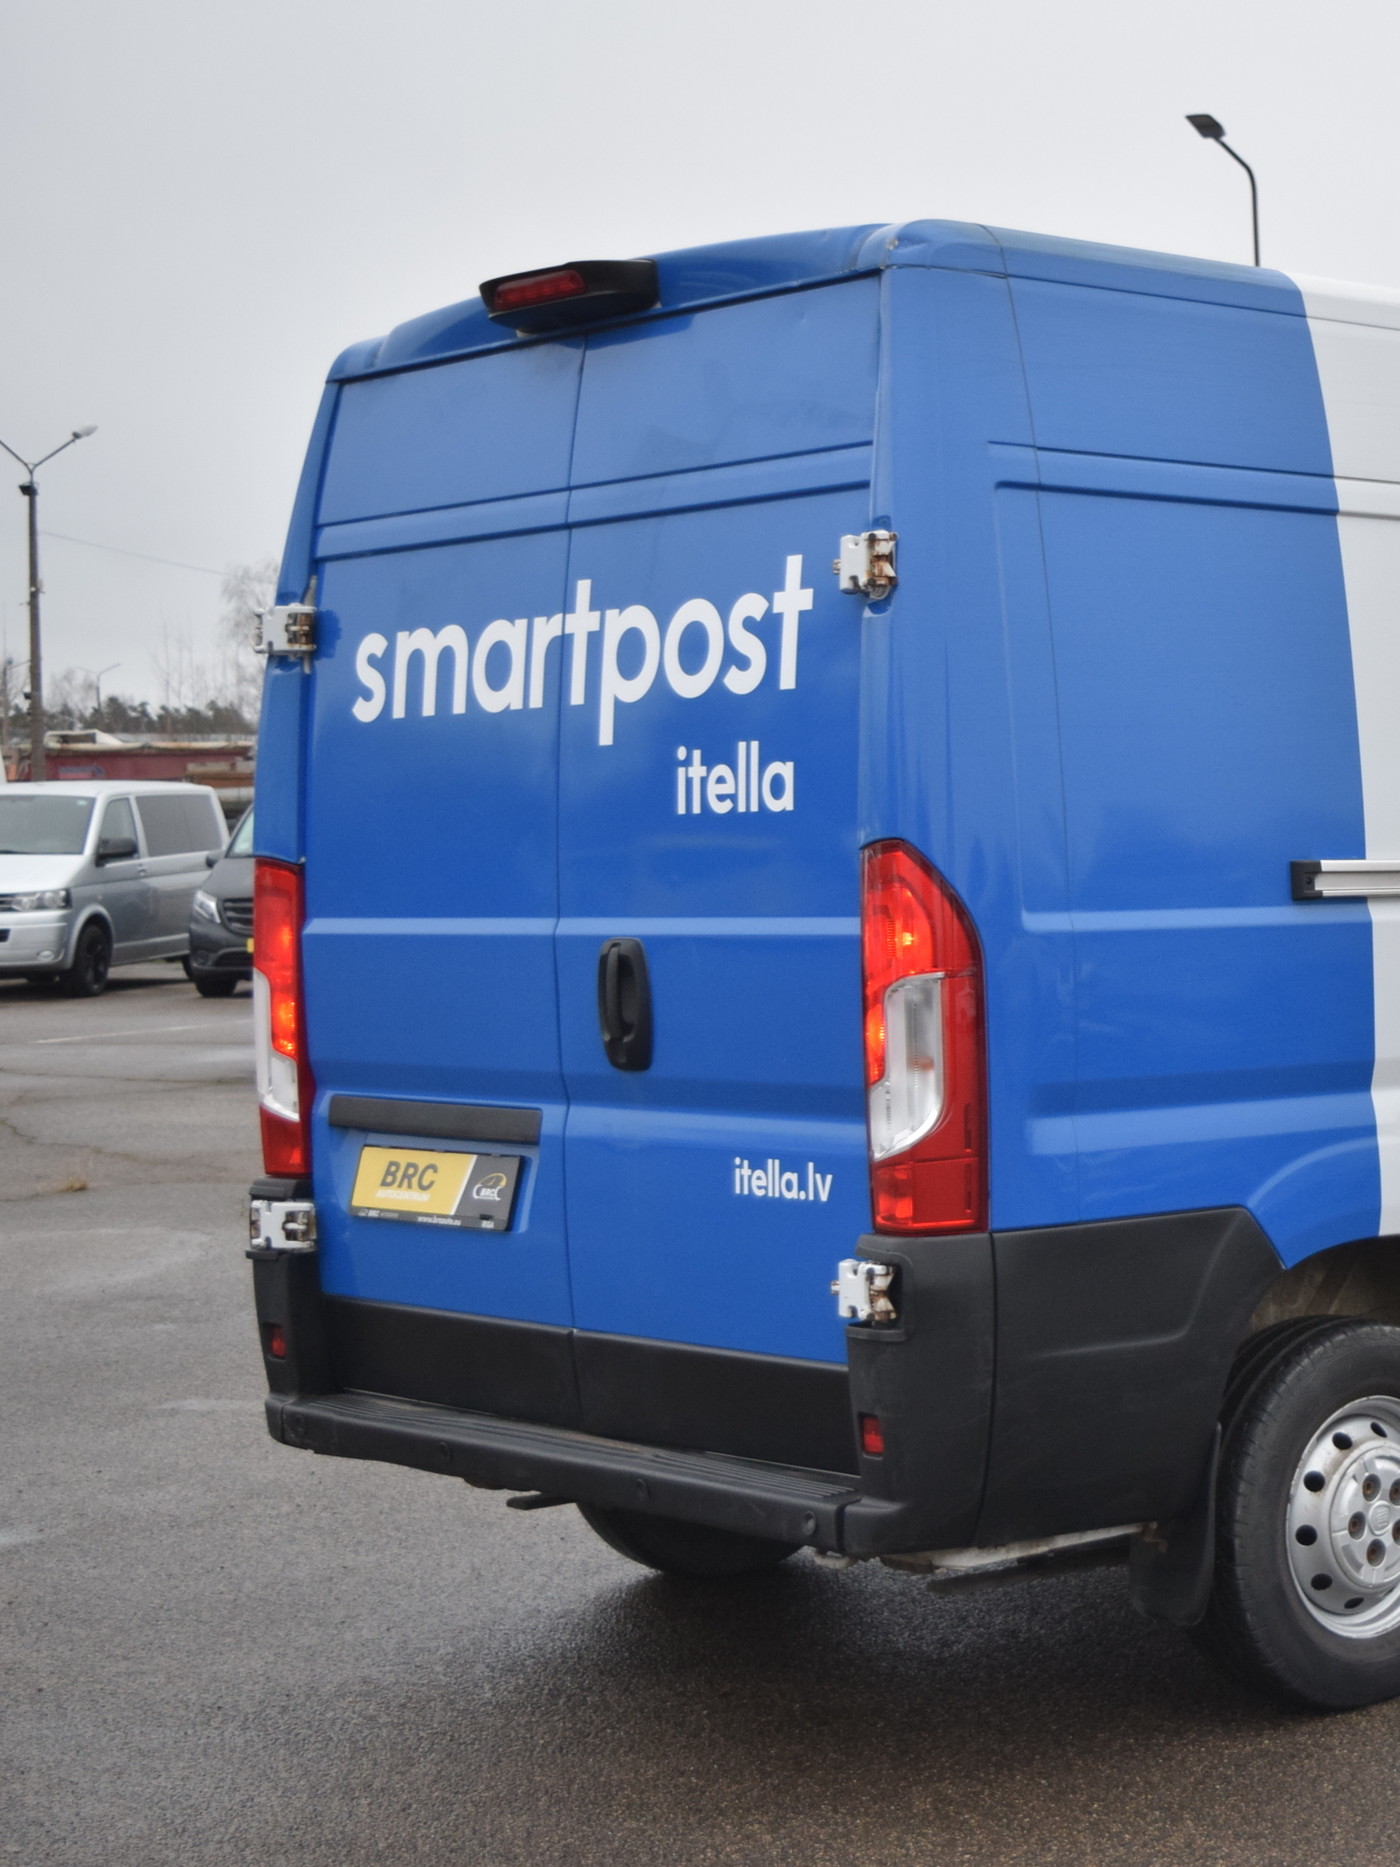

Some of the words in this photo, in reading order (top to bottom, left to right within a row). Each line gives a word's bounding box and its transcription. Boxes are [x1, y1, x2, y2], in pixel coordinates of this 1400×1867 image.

[352, 554, 813, 745] smartpost
[677, 741, 794, 814] itella
[380, 1160, 438, 1191] BRC
[735, 1157, 833, 1202] itella.lv
